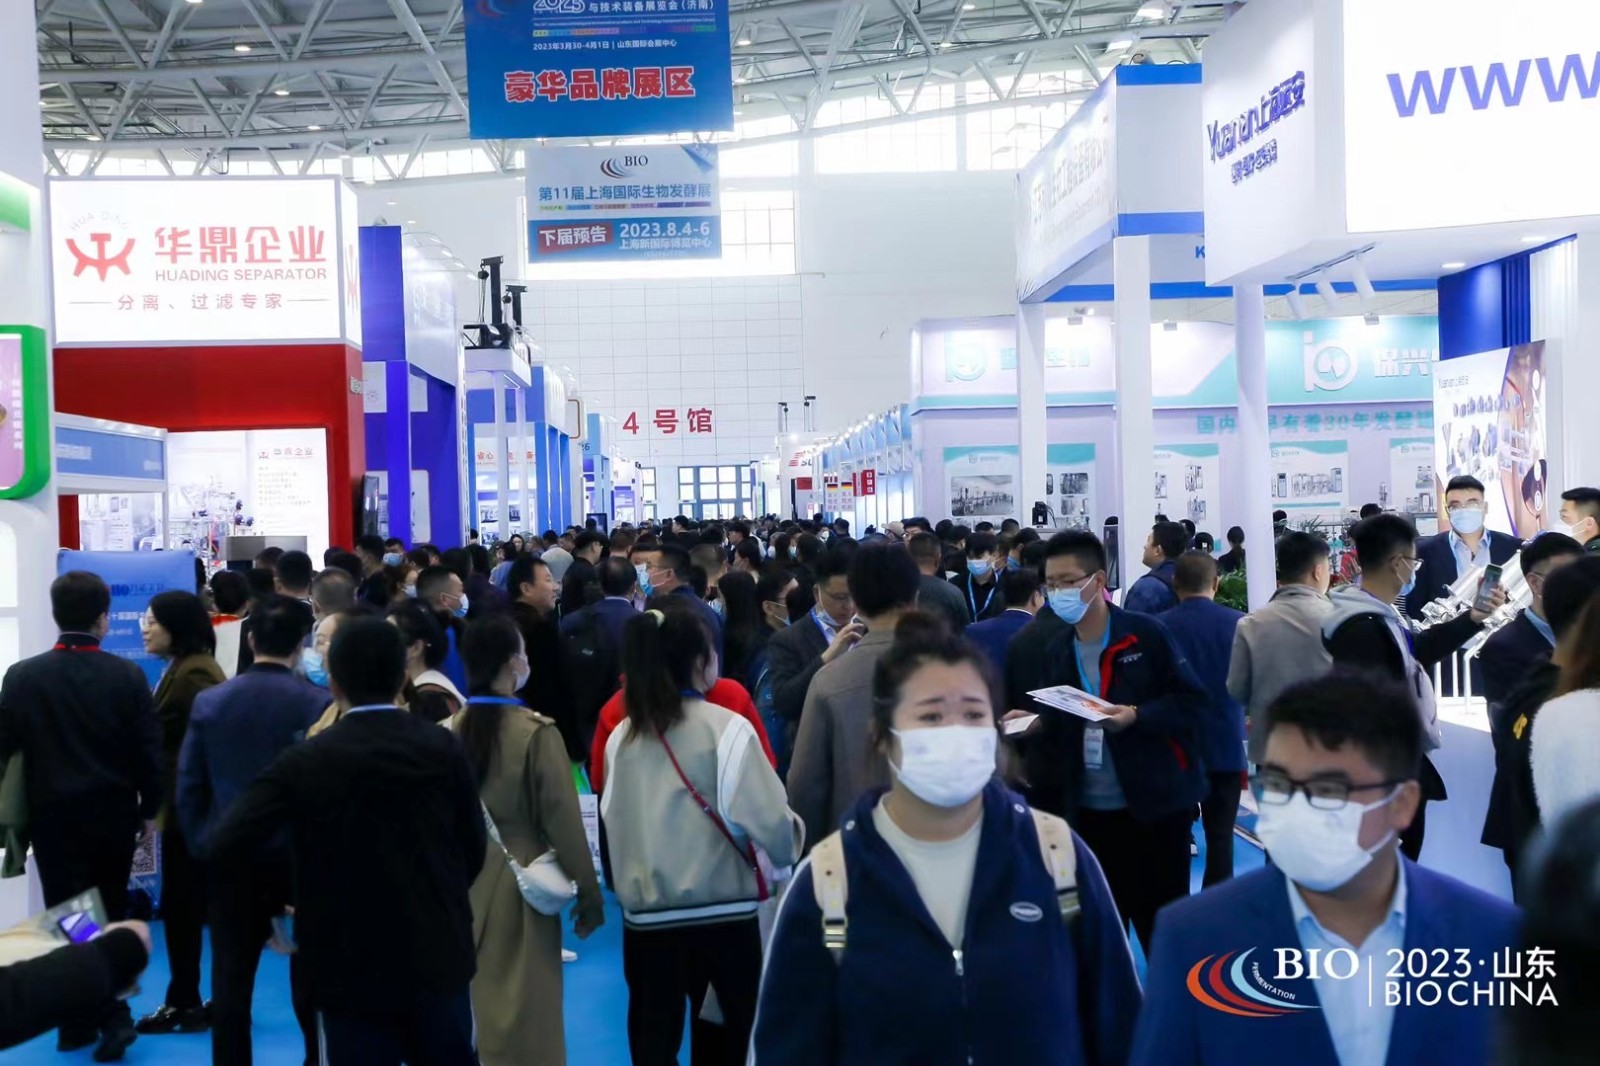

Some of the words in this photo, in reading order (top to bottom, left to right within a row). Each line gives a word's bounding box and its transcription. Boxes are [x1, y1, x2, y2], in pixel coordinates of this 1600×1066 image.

[504, 66, 696, 103] 豪华品牌展区
[624, 155, 649, 167] BIO
[539, 183, 712, 201] 第11届上海国际生物发酵展
[539, 226, 607, 247] 下届预告
[619, 221, 710, 238] 2023.8.4-6
[155, 225, 327, 265] 华鼎企业
[619, 238, 712, 250] 上海新国际博览中心
[155, 270, 229, 282] HUADING
[234, 268, 327, 281] SEPARATOR
[118, 292, 283, 311] 分离、过滤专家
